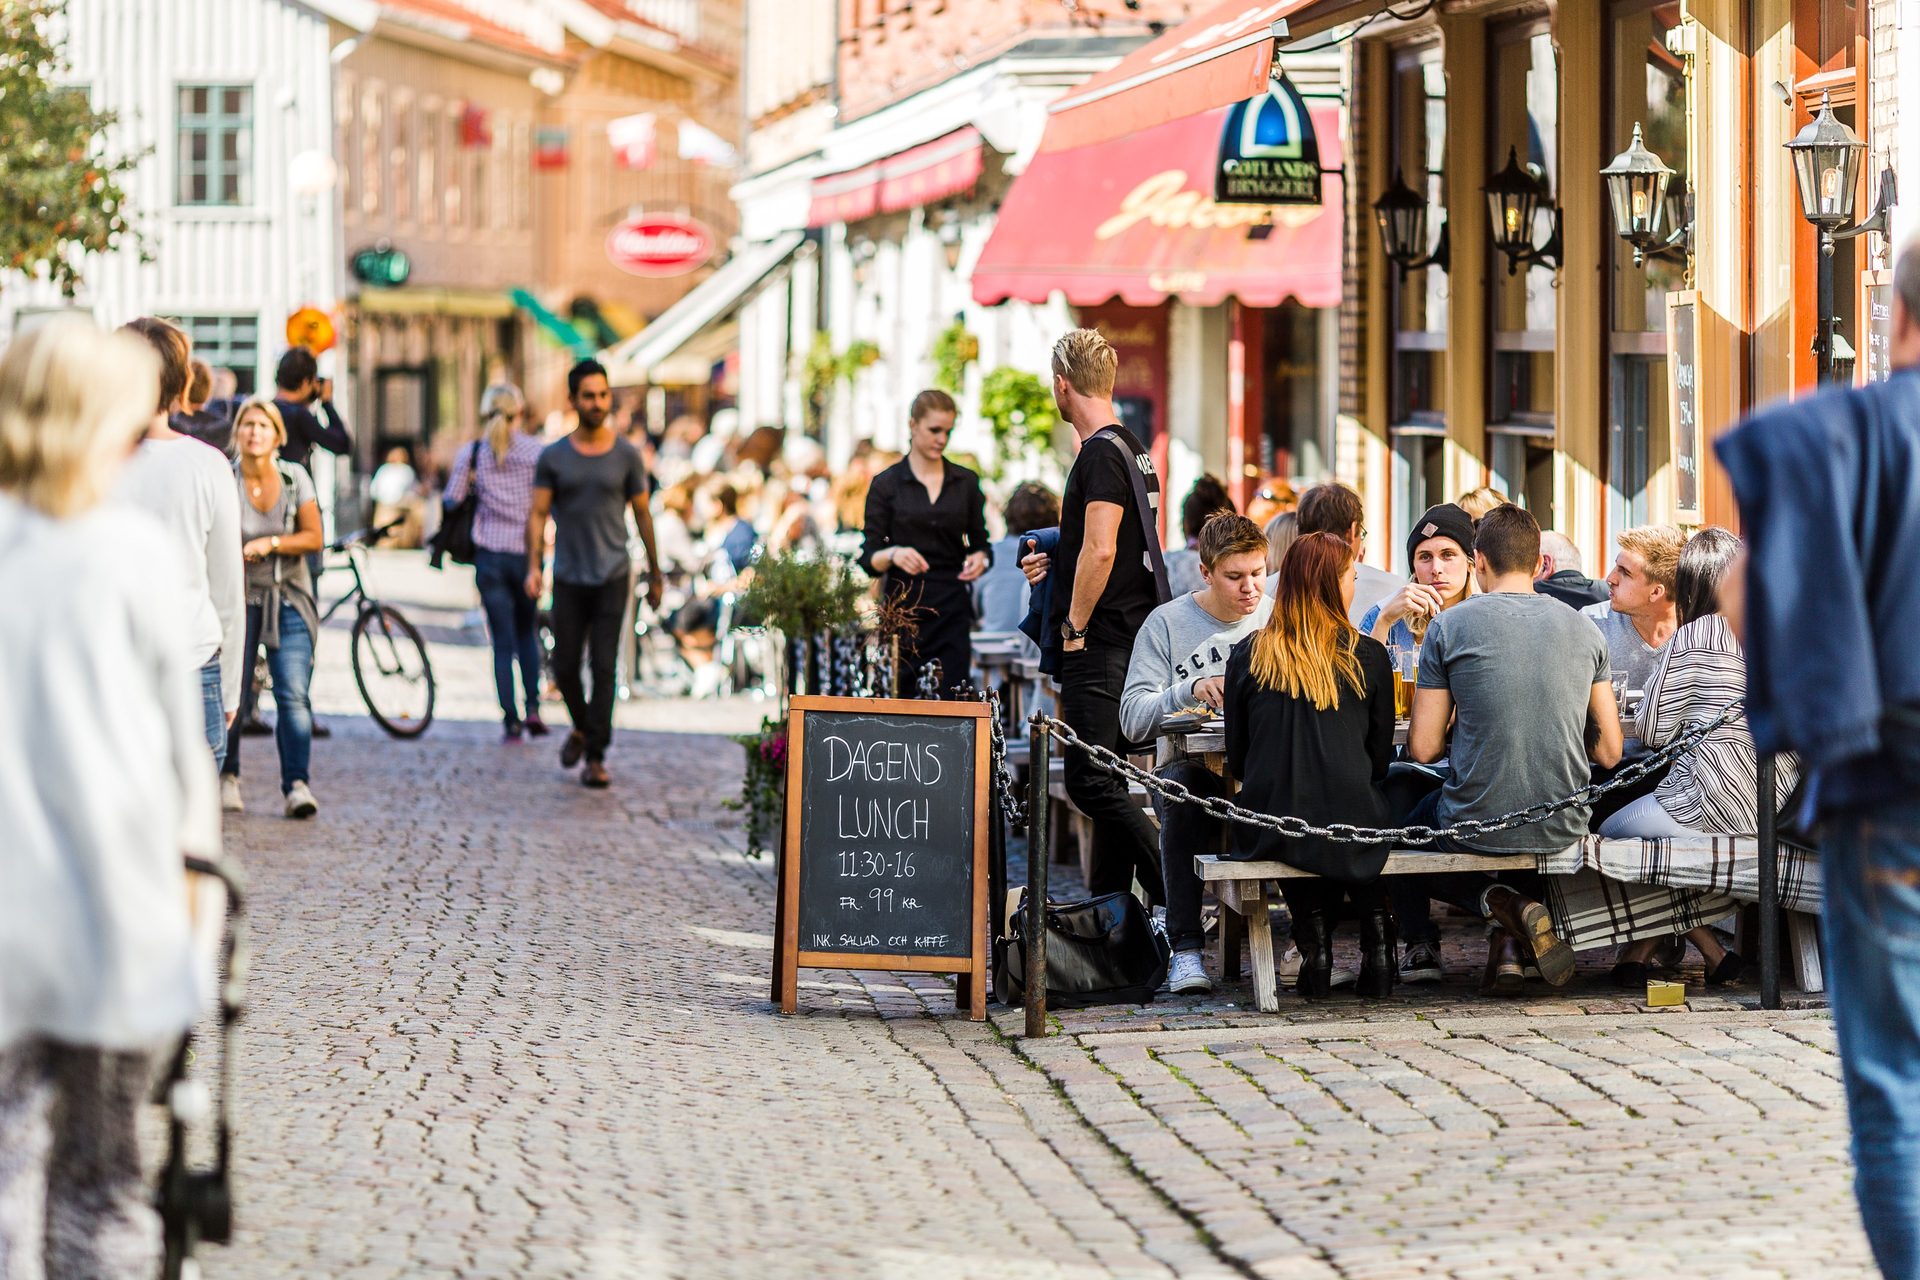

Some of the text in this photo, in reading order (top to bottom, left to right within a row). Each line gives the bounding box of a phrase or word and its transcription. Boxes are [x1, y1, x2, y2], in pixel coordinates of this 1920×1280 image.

[823, 735, 942, 785] DAGENS
[838, 794, 929, 840] LUNCH
[868, 887, 894, 913] 99
[812, 933, 950, 948] INK. SALLAD OCH KAFFE
